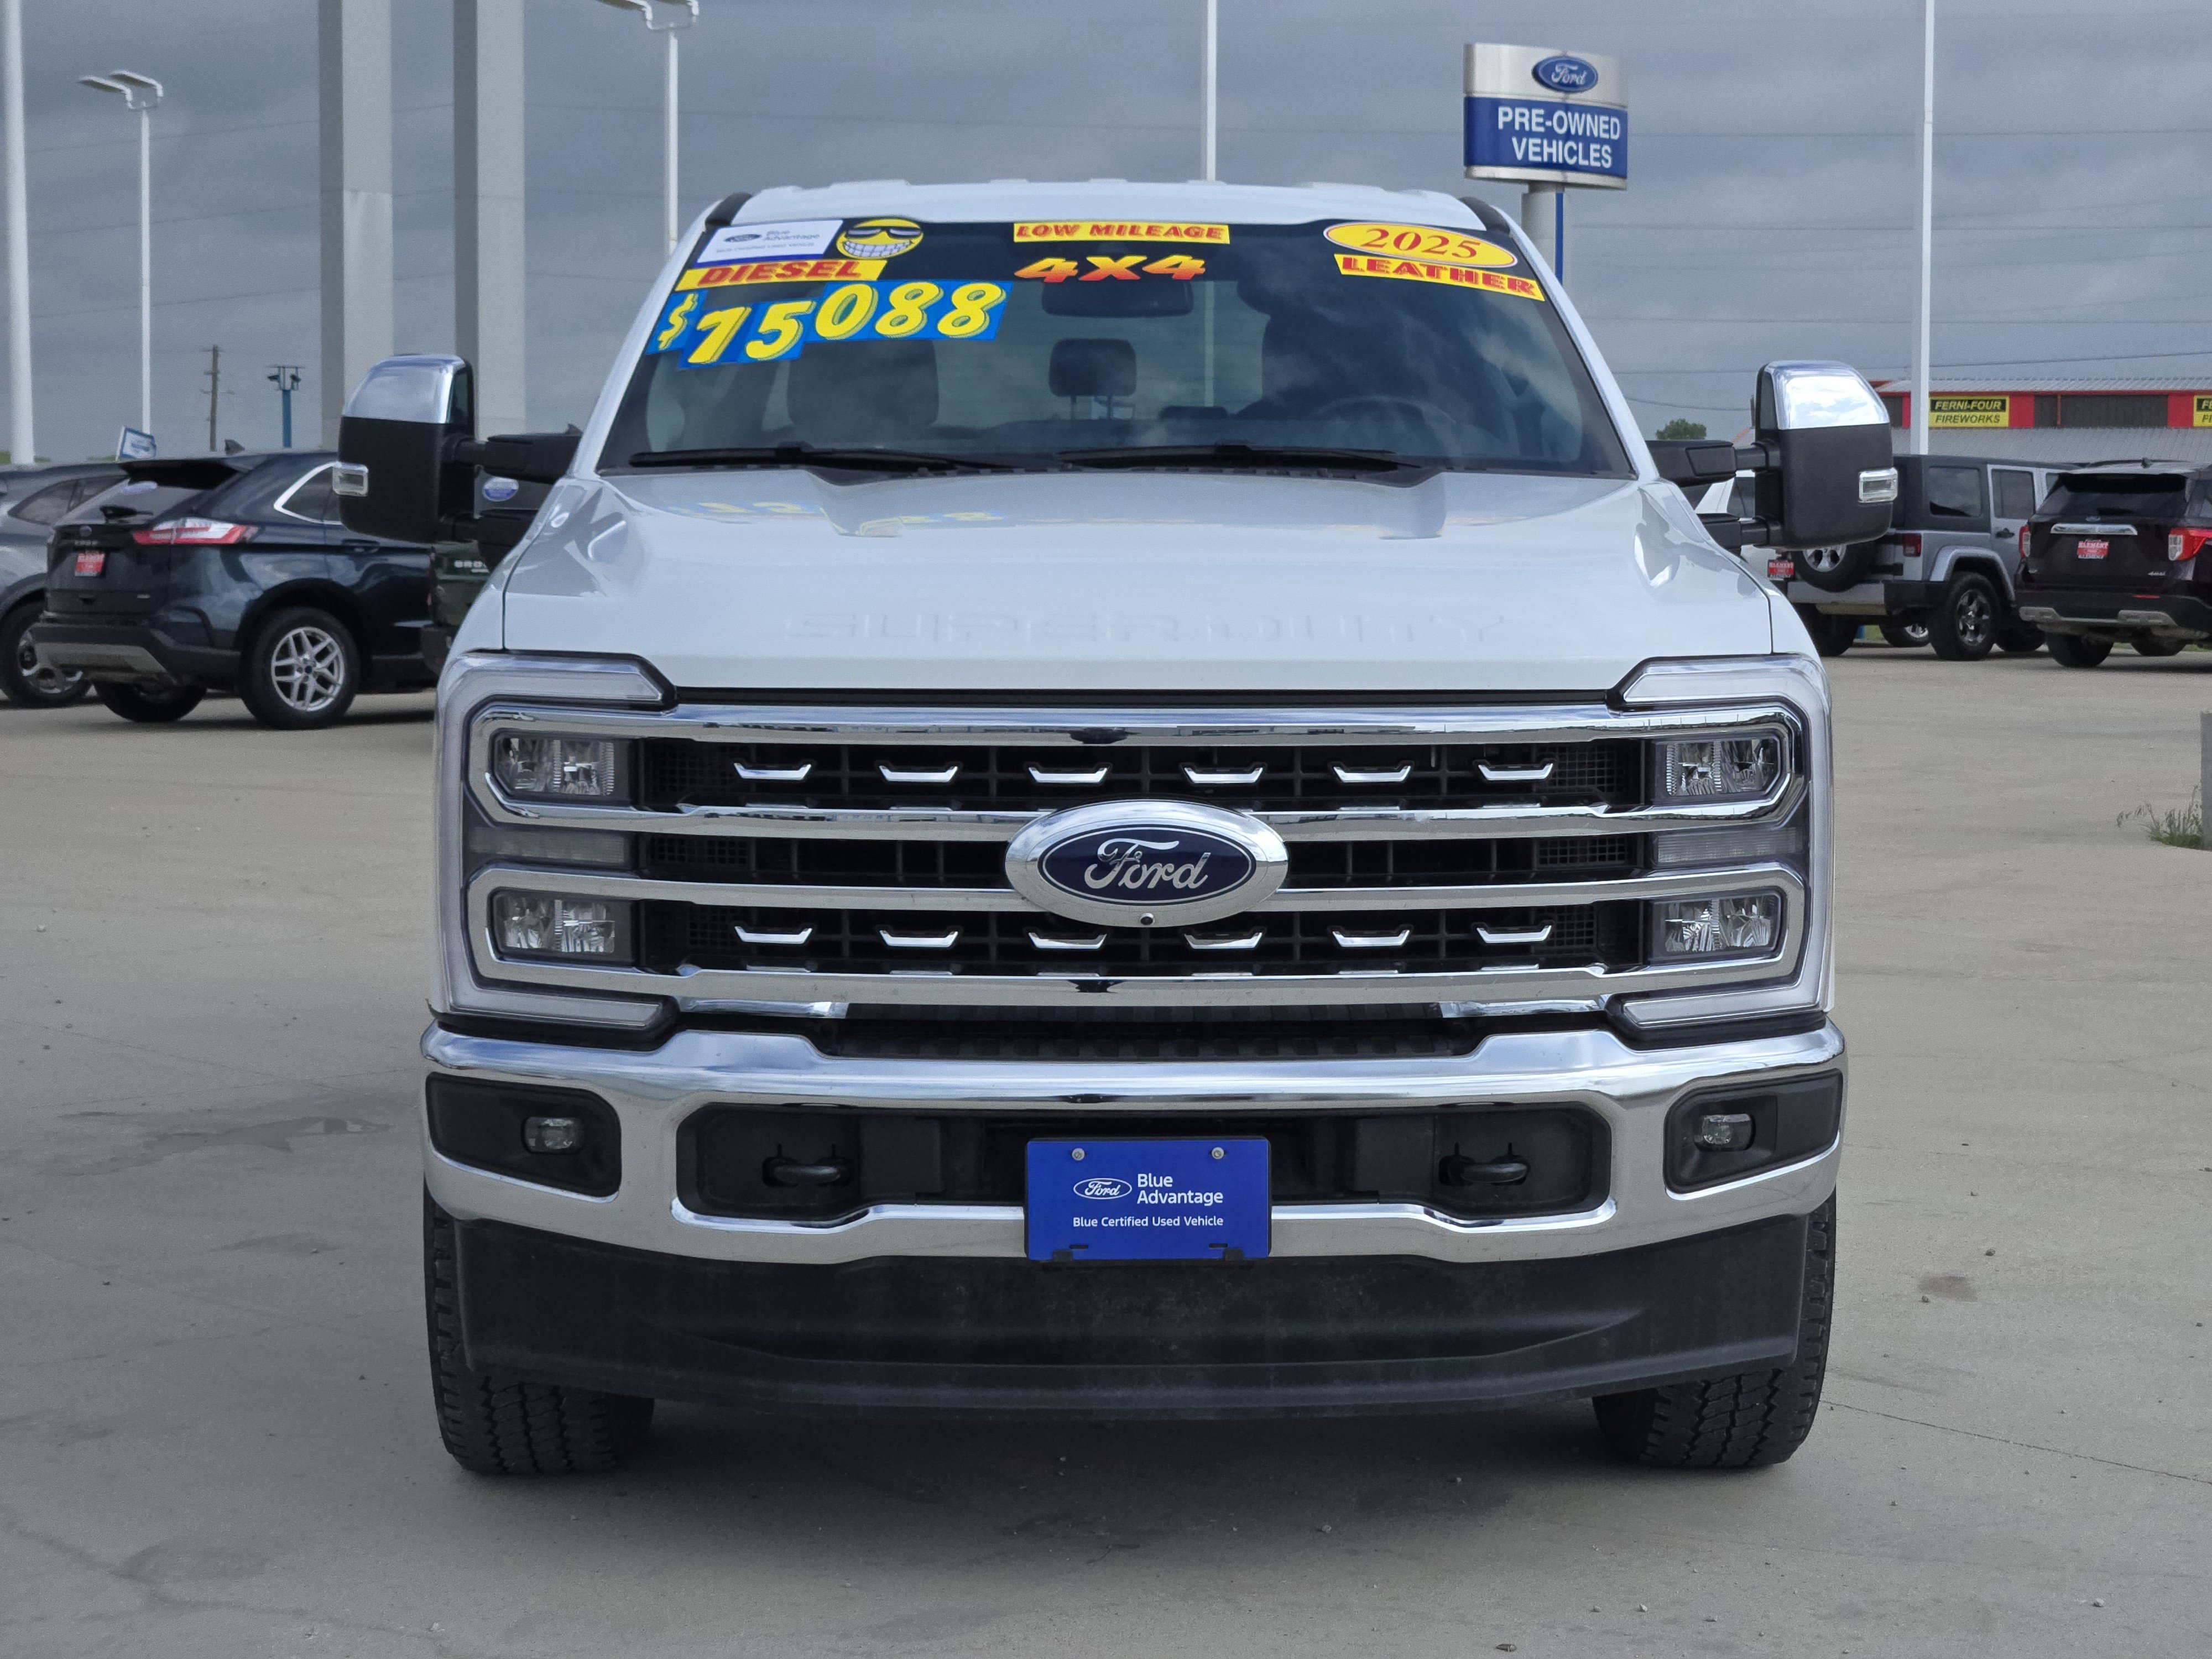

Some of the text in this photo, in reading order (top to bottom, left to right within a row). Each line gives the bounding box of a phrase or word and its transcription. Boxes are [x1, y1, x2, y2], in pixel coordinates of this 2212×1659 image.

[1551, 63, 1587, 85] Ford
[1498, 106, 1621, 140] PRE-OWNED
[1511, 137, 1612, 169] VEHICLES
[1016, 224, 1226, 240] LOW MILEAGE
[1360, 228, 1481, 259] 2025
[697, 261, 861, 287] DIESEL
[1342, 257, 1537, 296] LEATHER
[1935, 414, 2001, 424] FIREWORKS
[1084, 838, 1211, 889] Ford
[1084, 1180, 1121, 1197] Ford
[1137, 1173, 1173, 1188] Blue
[1137, 1190, 1223, 1207] Advantage
[1073, 1215, 1224, 1228] Blue Certified Used Vehicle
